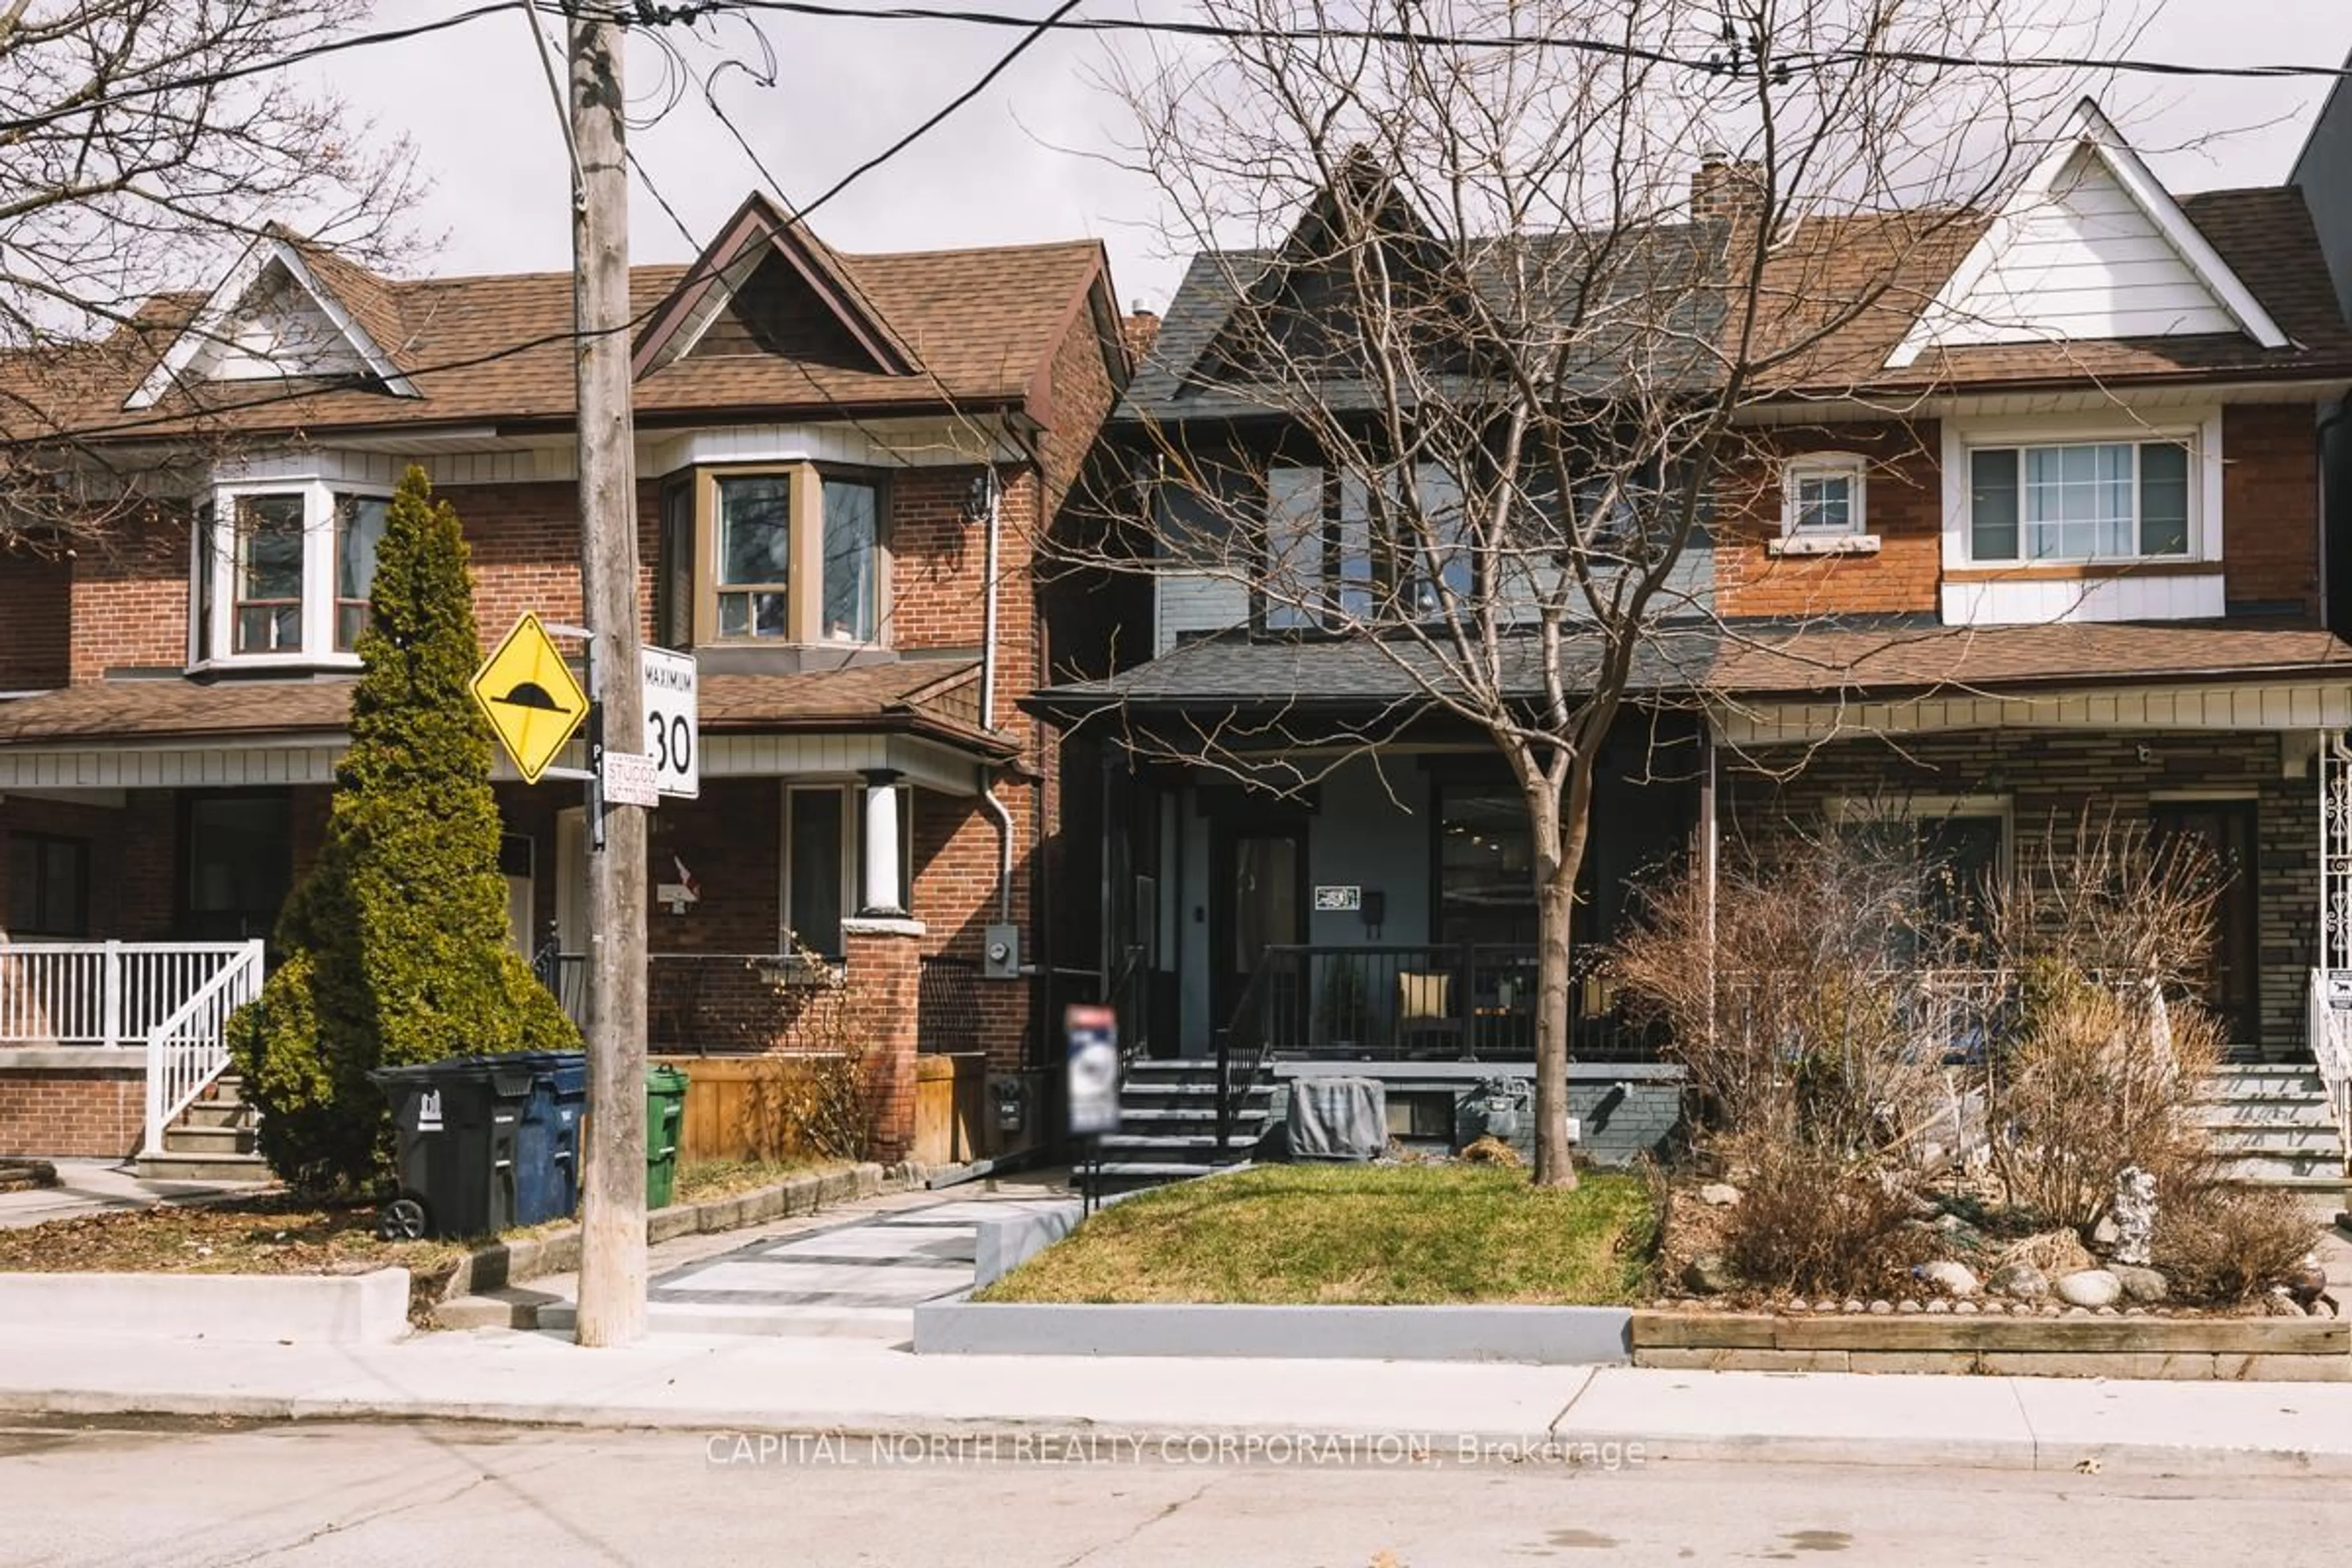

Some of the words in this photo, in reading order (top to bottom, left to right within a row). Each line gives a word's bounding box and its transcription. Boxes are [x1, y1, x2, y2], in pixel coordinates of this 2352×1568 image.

[645, 666, 691, 692] MAXIMUM
[649, 711, 690, 774] 30
[609, 763, 658, 783] STUCCO
